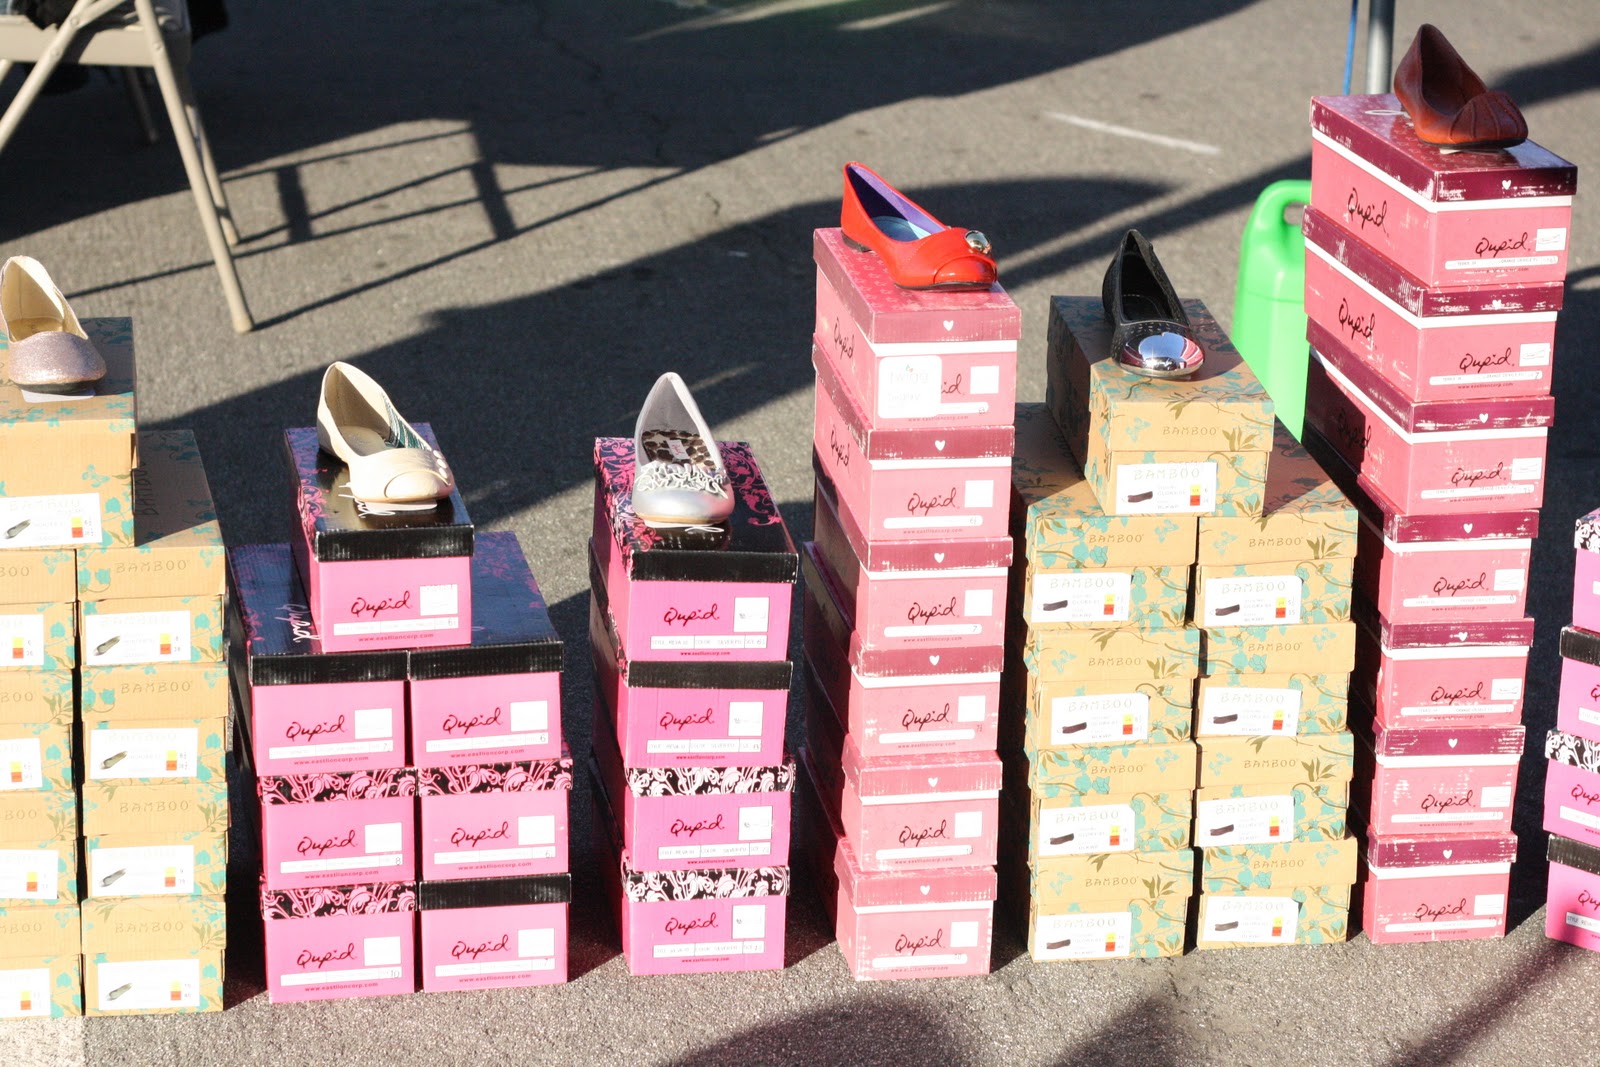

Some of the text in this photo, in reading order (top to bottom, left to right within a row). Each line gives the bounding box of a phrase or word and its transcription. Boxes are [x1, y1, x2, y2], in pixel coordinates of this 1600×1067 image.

[1348, 187, 1387, 230] Qupid
[1476, 232, 1528, 256] Qupid
[1339, 298, 1375, 341] Qupid
[1460, 348, 1512, 373] Qupid
[1163, 427, 1217, 435] BAMBOO
[1134, 468, 1200, 480] BAMBOO
[1452, 462, 1503, 487] Qupid
[908, 488, 956, 516] Qupid
[1089, 534, 1142, 543] BAMBOO
[1249, 538, 1301, 547] BAMBOO
[115, 560, 188, 574] BAMBOO
[1050, 578, 1115, 588] BAMBOO
[1221, 581, 1285, 592] BAMBOO
[1434, 573, 1486, 596] Qupid
[350, 591, 410, 617] Qupid
[664, 603, 718, 626] Qupid
[908, 597, 956, 624] Qupid
[1248, 642, 1300, 651] BAMBOO
[1088, 657, 1142, 666] BAMBOO
[121, 682, 191, 694] BAMBOO
[1431, 682, 1483, 706] Qupid
[286, 715, 345, 741] Qupid
[443, 707, 501, 734] Qupid
[660, 708, 712, 731] Qupid
[902, 703, 949, 731] Qupid
[1091, 765, 1144, 774] BAMBOO
[1244, 759, 1296, 768] BAMBOO
[120, 802, 188, 813] BAMBOO
[1421, 790, 1473, 813] Qupid
[451, 822, 508, 847] Qupid
[671, 814, 723, 837] Qupid
[899, 820, 946, 847] Qupid
[297, 830, 355, 856] Qupid
[1253, 859, 1304, 868] BAMBOO
[1085, 876, 1137, 887] BAMBOO
[1415, 899, 1466, 921] Qupid
[115, 922, 184, 933] BAMBOO
[665, 912, 717, 935] Qupid
[452, 934, 508, 959] Qupid
[895, 929, 943, 955] Qupid
[297, 943, 355, 968] Qupid
